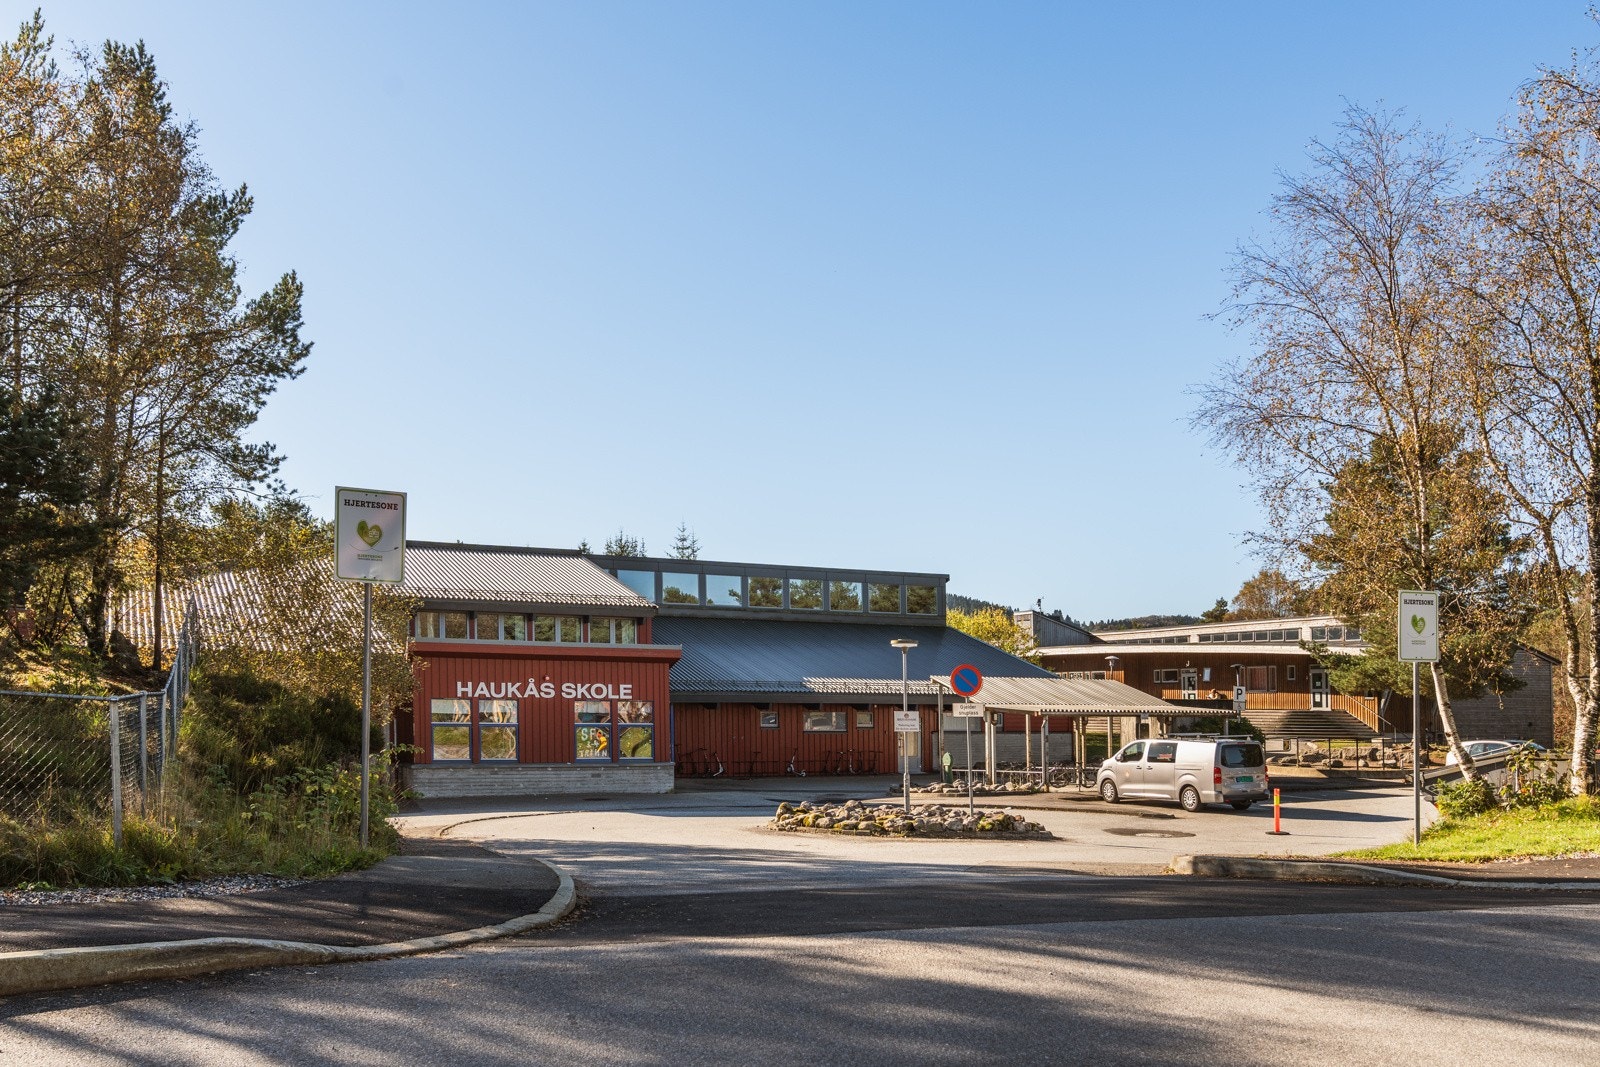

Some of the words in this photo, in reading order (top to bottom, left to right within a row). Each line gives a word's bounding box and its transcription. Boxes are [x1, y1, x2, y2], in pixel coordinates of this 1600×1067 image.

[344, 499, 399, 511] HJERTESONE
[456, 678, 556, 699] HAUKÅS
[561, 682, 633, 700] SKOLE
[1236, 688, 1242, 699] P
